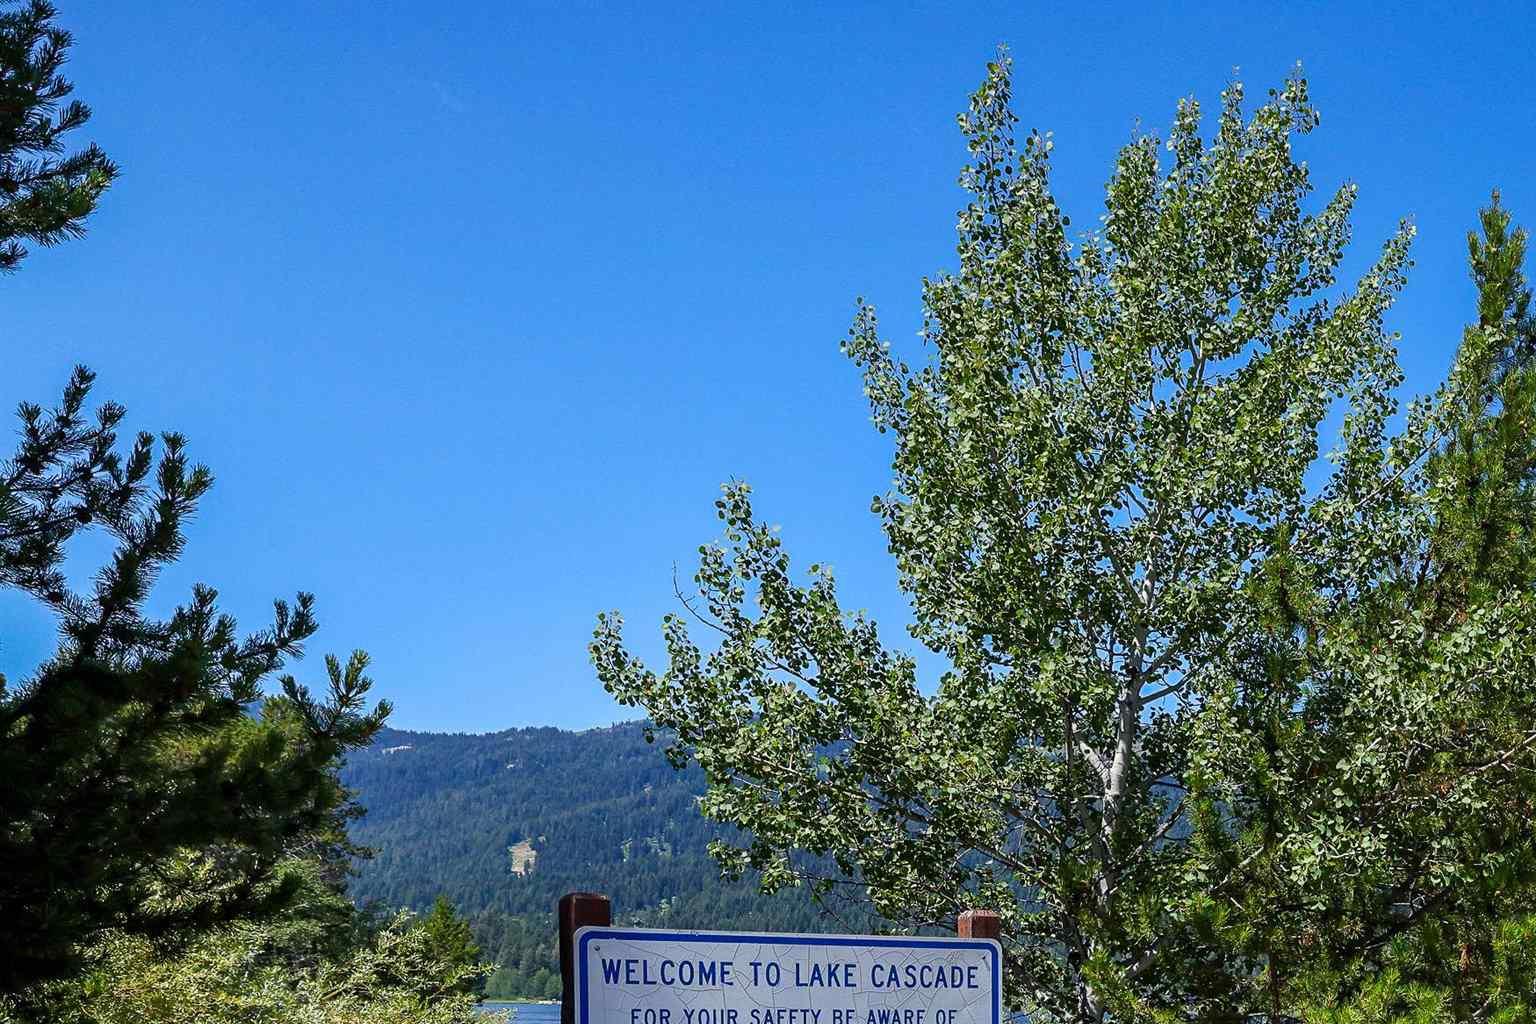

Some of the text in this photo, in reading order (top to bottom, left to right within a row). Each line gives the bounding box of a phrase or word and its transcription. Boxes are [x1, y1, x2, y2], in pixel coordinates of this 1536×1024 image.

[601, 958, 979, 989] WELCOME TO LAKE CASCADE
